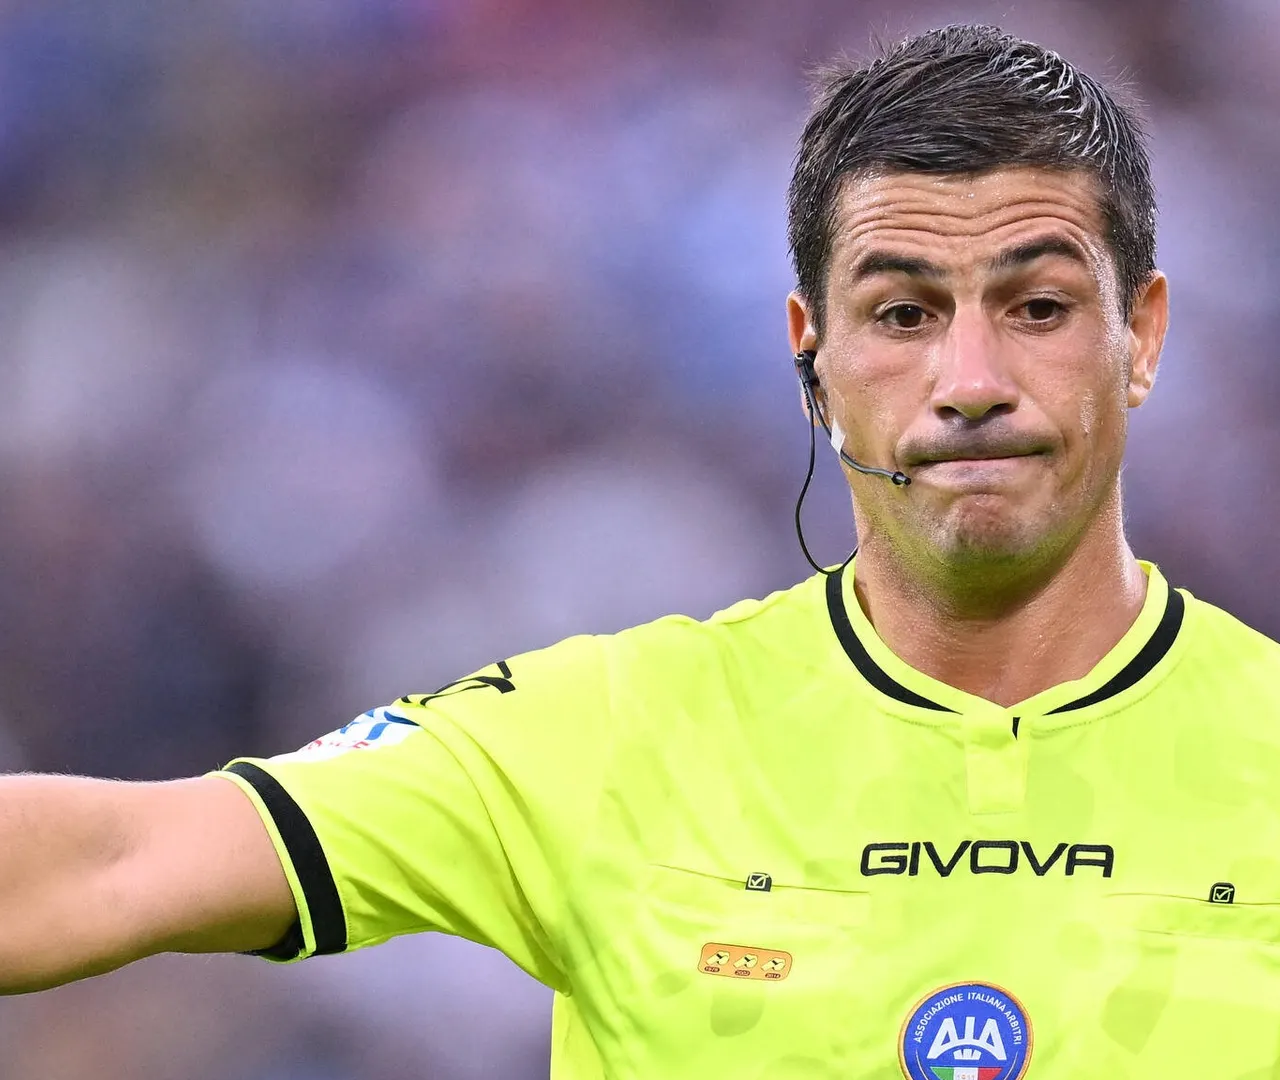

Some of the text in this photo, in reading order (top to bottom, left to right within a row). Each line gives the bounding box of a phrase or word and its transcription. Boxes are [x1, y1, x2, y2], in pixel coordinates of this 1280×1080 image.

[860, 840, 1115, 877] GIVOVA
[914, 992, 1022, 1045] ASSOCIAZIONE ITALIANA ARBITRI
[926, 1016, 1008, 1061] AIA
